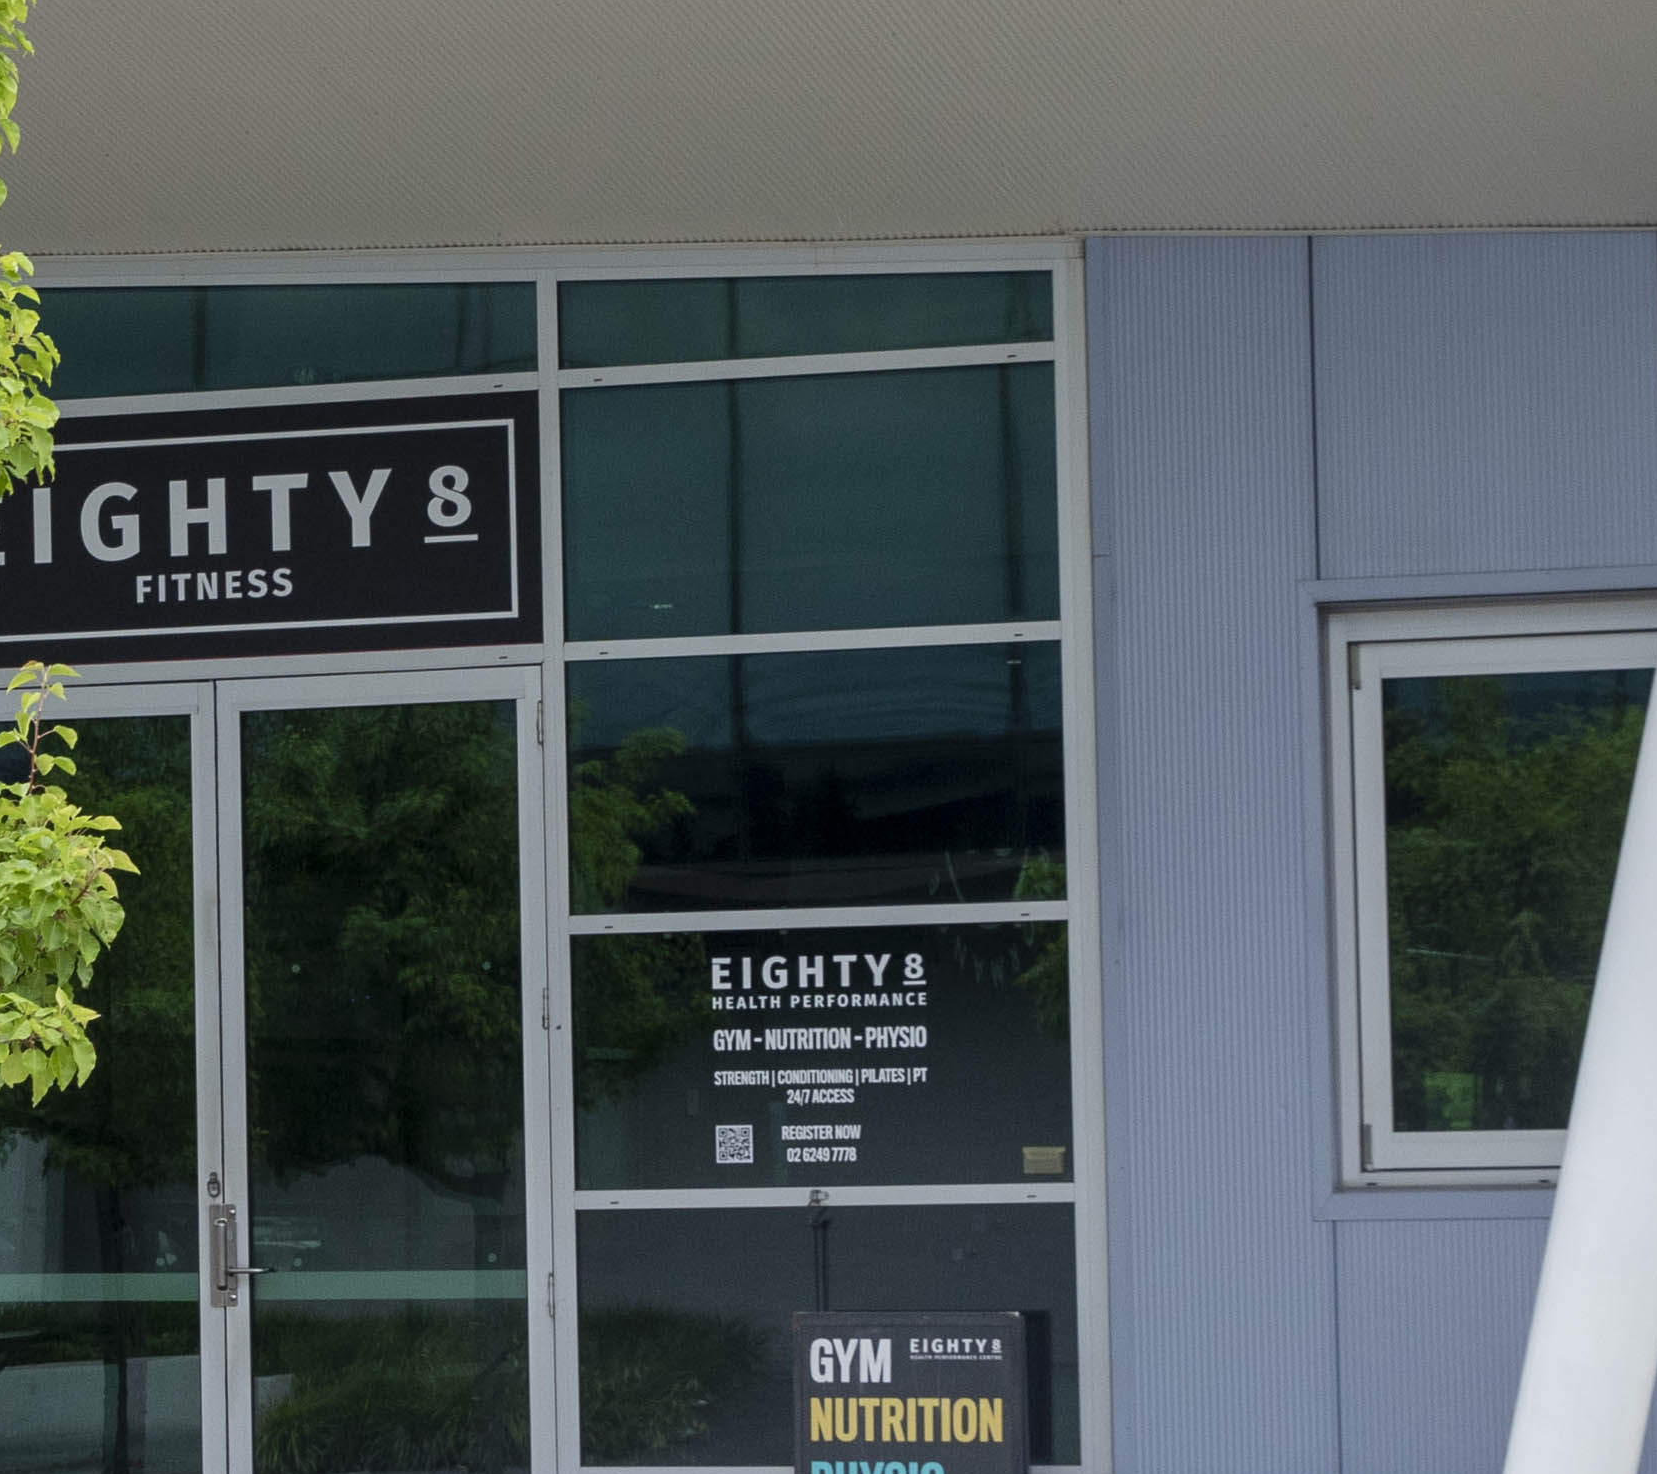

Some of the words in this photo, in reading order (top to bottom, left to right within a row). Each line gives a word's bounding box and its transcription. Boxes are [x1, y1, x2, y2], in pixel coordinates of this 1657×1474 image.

[135, 568, 293, 603] FITNESS
[712, 996, 781, 1010] HEALTH
[790, 993, 927, 1009] PERFORMANCE
[713, 1028, 751, 1052] GYM
[764, 1027, 852, 1051] NUTRITION
[865, 1025, 928, 1049] PHYSIO
[713, 1070, 770, 1086] STRENGTH
[777, 1069, 853, 1085] CONDITIONING
[861, 1068, 906, 1084] PILATES
[913, 1067, 928, 1083] PT
[787, 1089, 811, 1107] 24/7
[811, 1089, 856, 1104] ACCESS
[781, 1125, 833, 1142] REGISTER
[834, 1124, 862, 1141] NOW
[786, 1147, 802, 1163] 02
[802, 1147, 831, 1163] 6249
[831, 1146, 858, 1163] 7778
[809, 1337, 892, 1384] GYM
[810, 1397, 1003, 1443] NUTRITION
